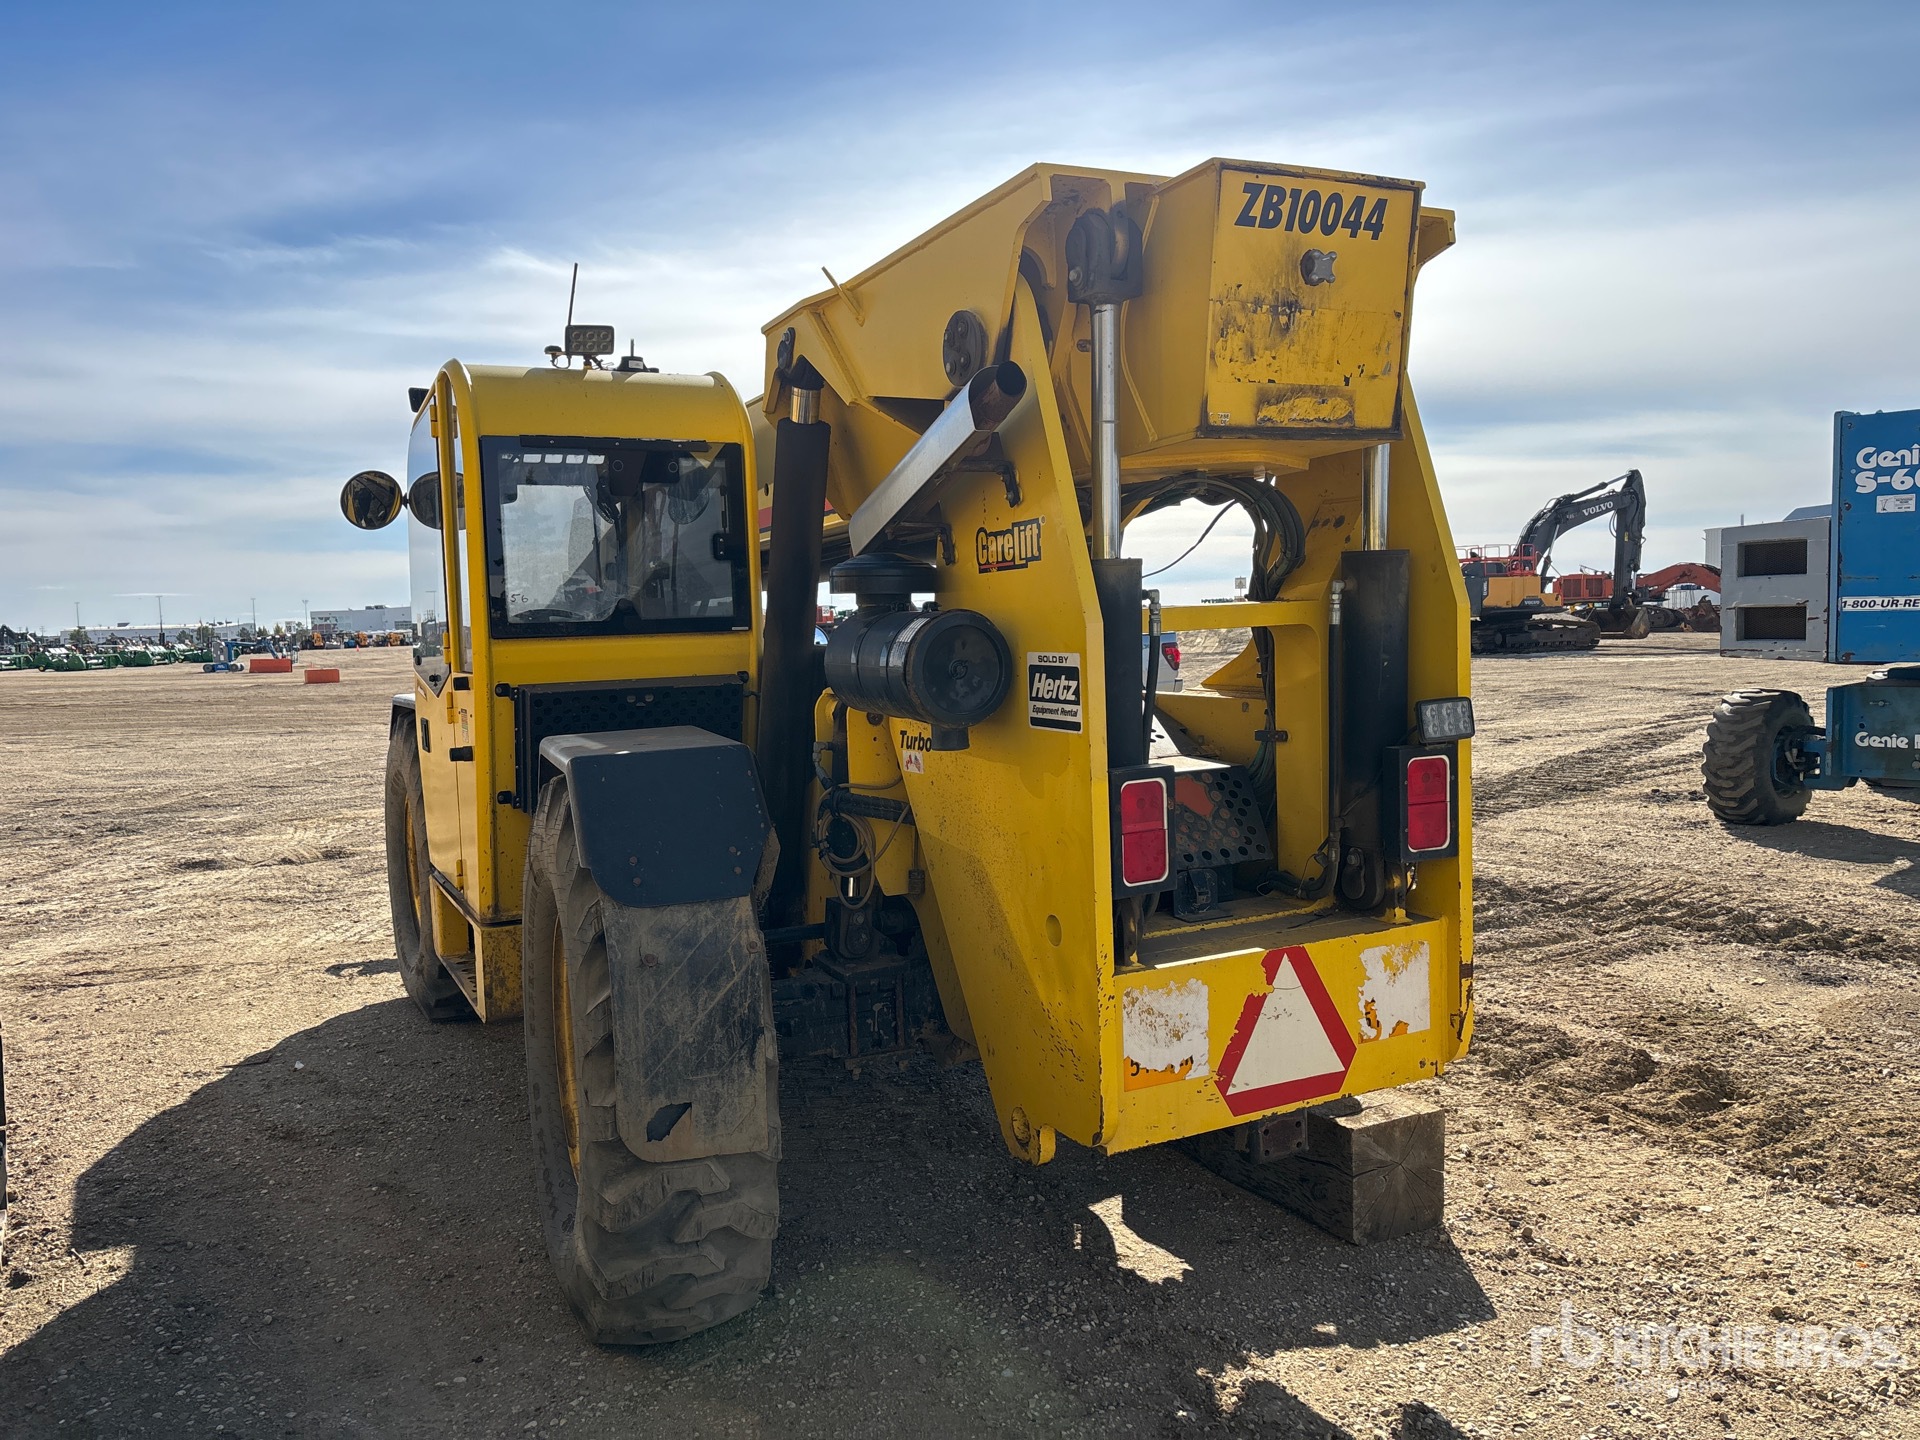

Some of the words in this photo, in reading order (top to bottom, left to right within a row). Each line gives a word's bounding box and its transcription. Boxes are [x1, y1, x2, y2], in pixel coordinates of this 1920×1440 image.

[1234, 181, 1389, 241] ZB10044
[1856, 443, 1920, 469] Geni
[1855, 468, 1920, 494] S-6
[1582, 501, 1614, 516] VOLVO
[977, 522, 1040, 566] CareLift
[1037, 655, 1057, 663] SOLD
[1058, 656, 1069, 664] BY
[1031, 672, 1078, 701] Hertz
[1032, 705, 1060, 716] Equipment
[1060, 708, 1079, 717] Rental
[900, 730, 932, 752] Turbo
[1854, 731, 1909, 749] Genie
